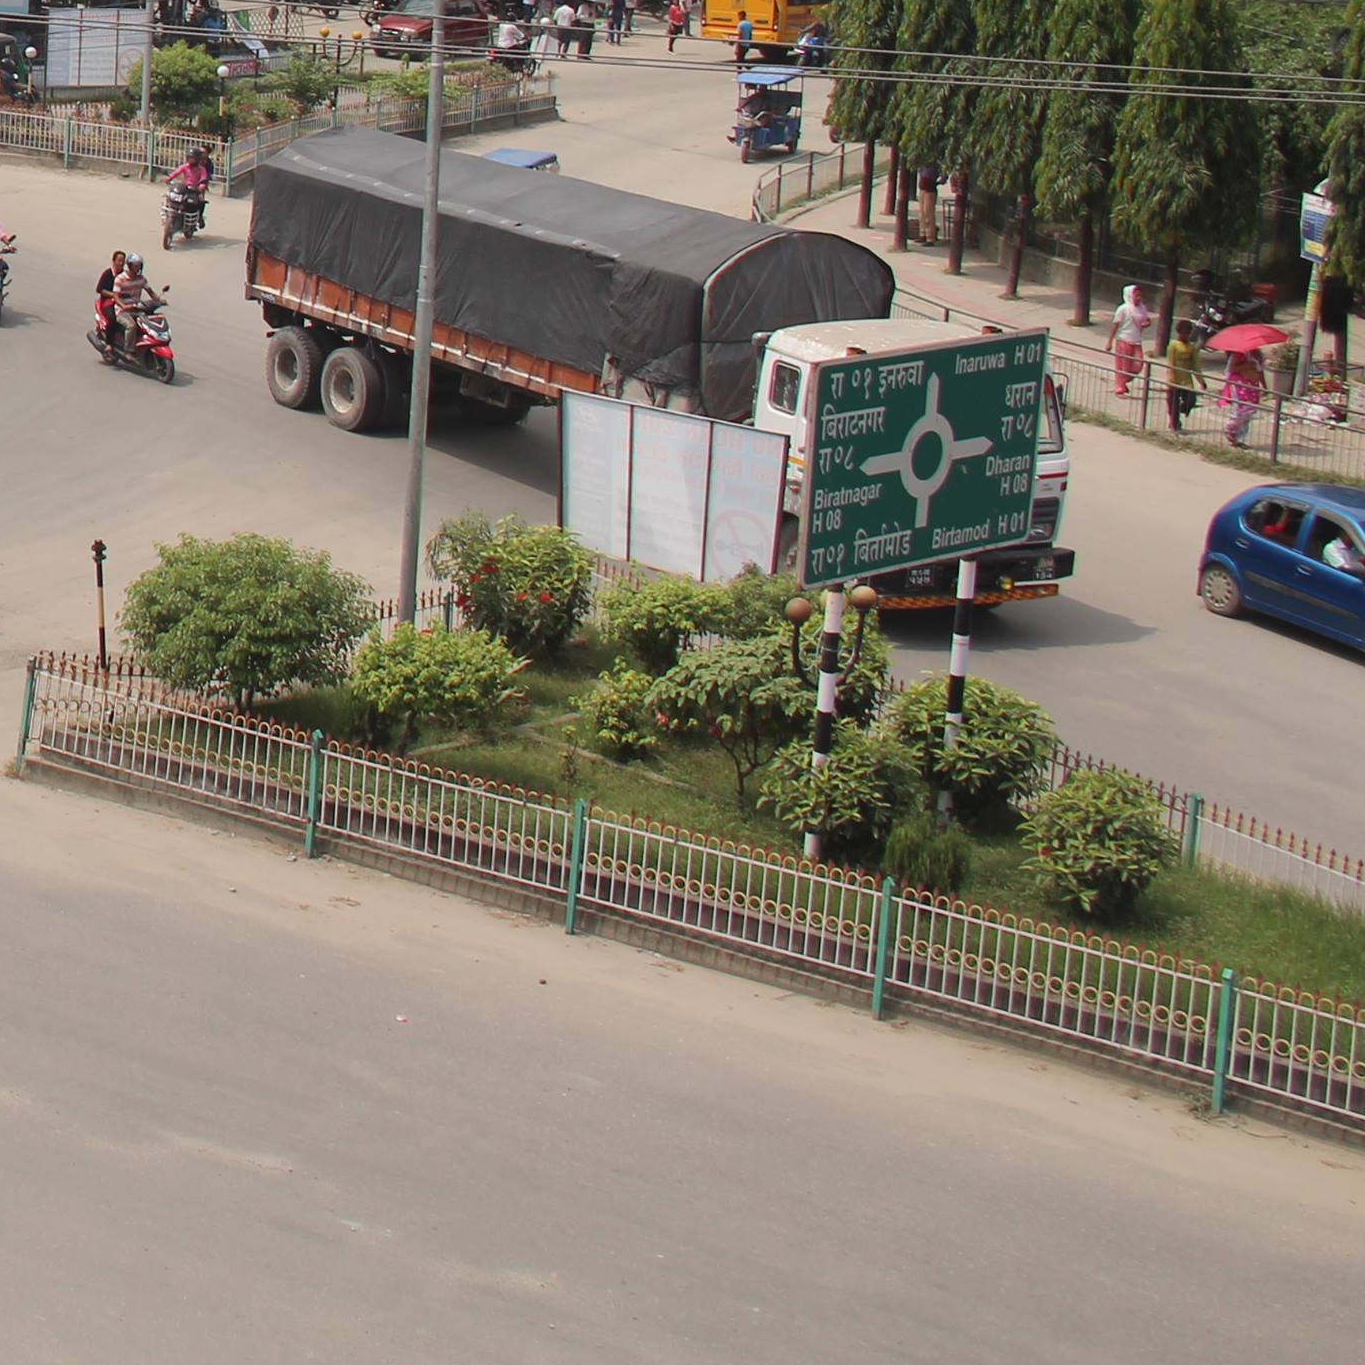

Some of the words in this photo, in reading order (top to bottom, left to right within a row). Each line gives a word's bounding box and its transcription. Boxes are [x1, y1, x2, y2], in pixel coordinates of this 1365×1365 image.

[955, 352, 1005, 375] Inaruwa
[1014, 345, 1025, 366] H
[1027, 342, 1042, 364] 01
[878, 360, 925, 398] इनरुवा
[1005, 381, 1038, 408] धरान
[821, 403, 886, 441] बिराटनगर
[985, 454, 1031, 477] Dharan
[814, 482, 883, 511] Biratnagar
[1000, 477, 1011, 497] H
[1012, 474, 1029, 493] 08
[812, 513, 822, 534] H
[825, 509, 842, 531] 08
[931, 519, 990, 550] Birtamod
[998, 514, 1008, 535] H
[1010, 511, 1025, 533] 01
